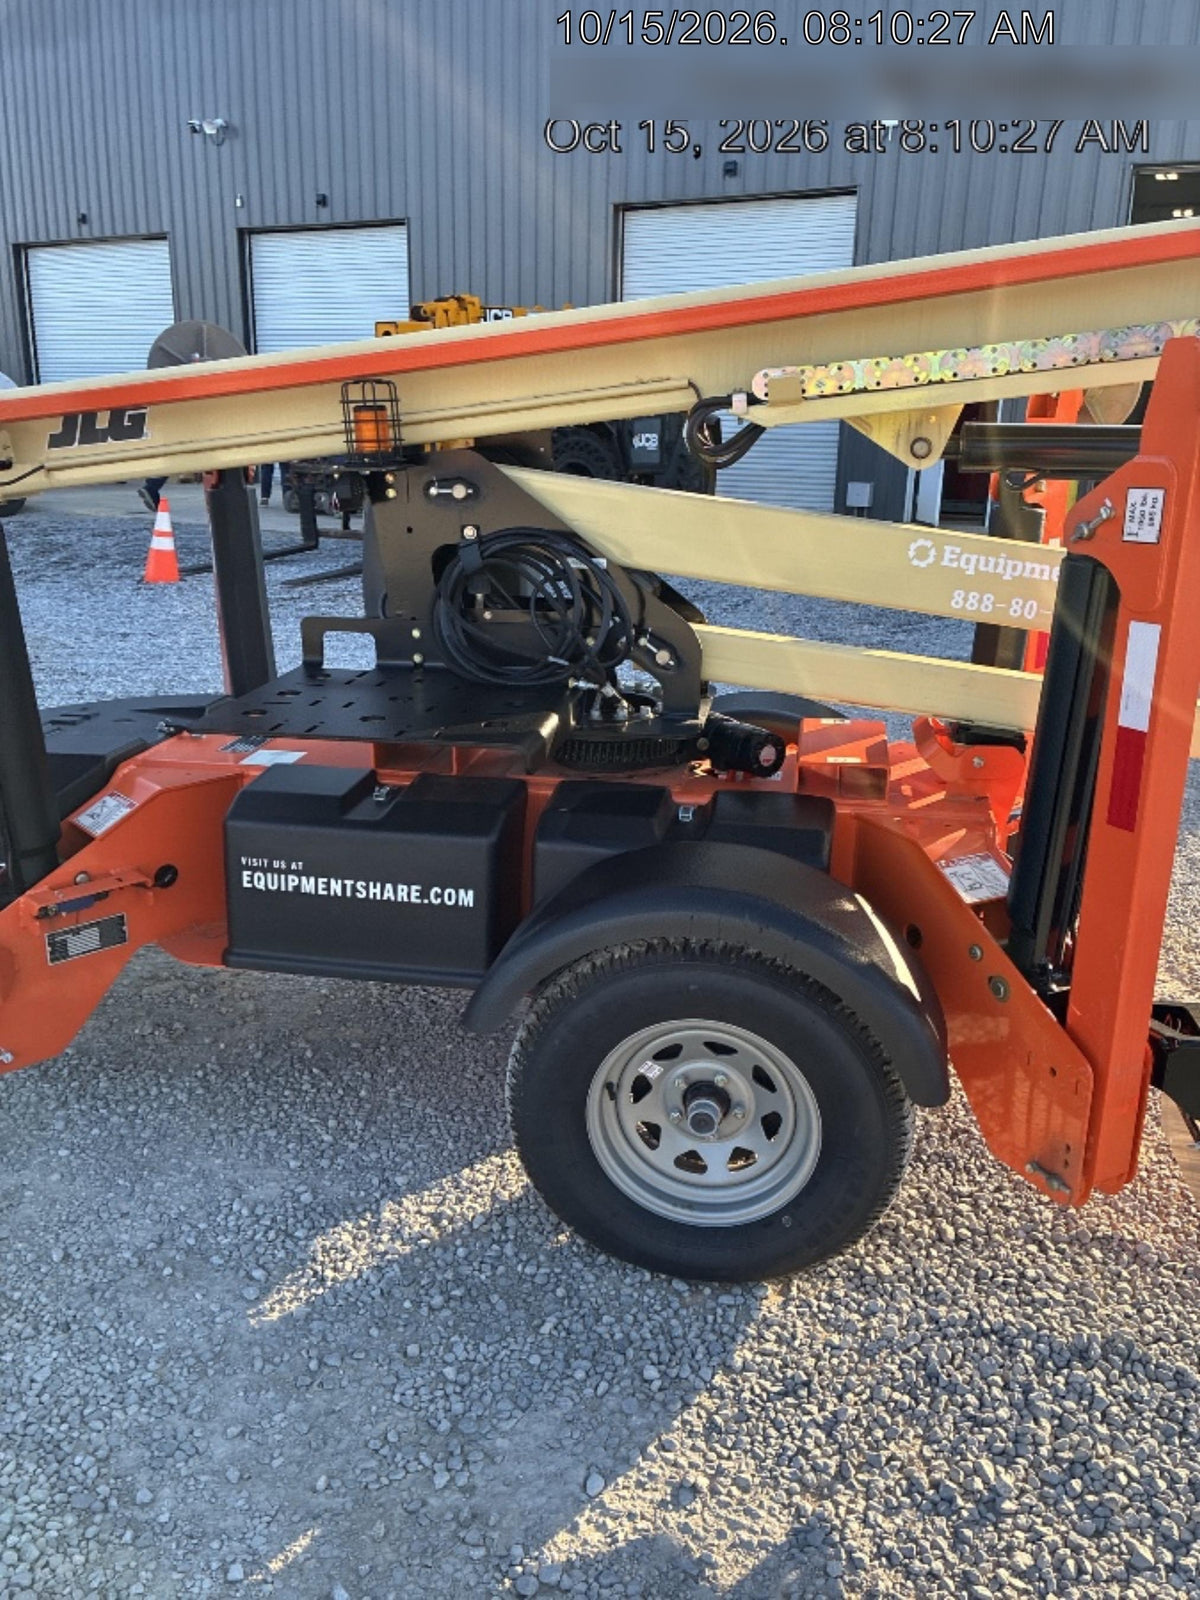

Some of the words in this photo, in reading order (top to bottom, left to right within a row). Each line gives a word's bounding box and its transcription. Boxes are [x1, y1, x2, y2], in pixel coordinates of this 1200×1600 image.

[46, 407, 149, 450] JLG
[638, 432, 659, 448] JCB
[240, 856, 269, 869] VISIT
[272, 858, 287, 870] US
[291, 861, 304, 871] AT
[241, 870, 475, 908] EQUIPMENTSHARE.COM
